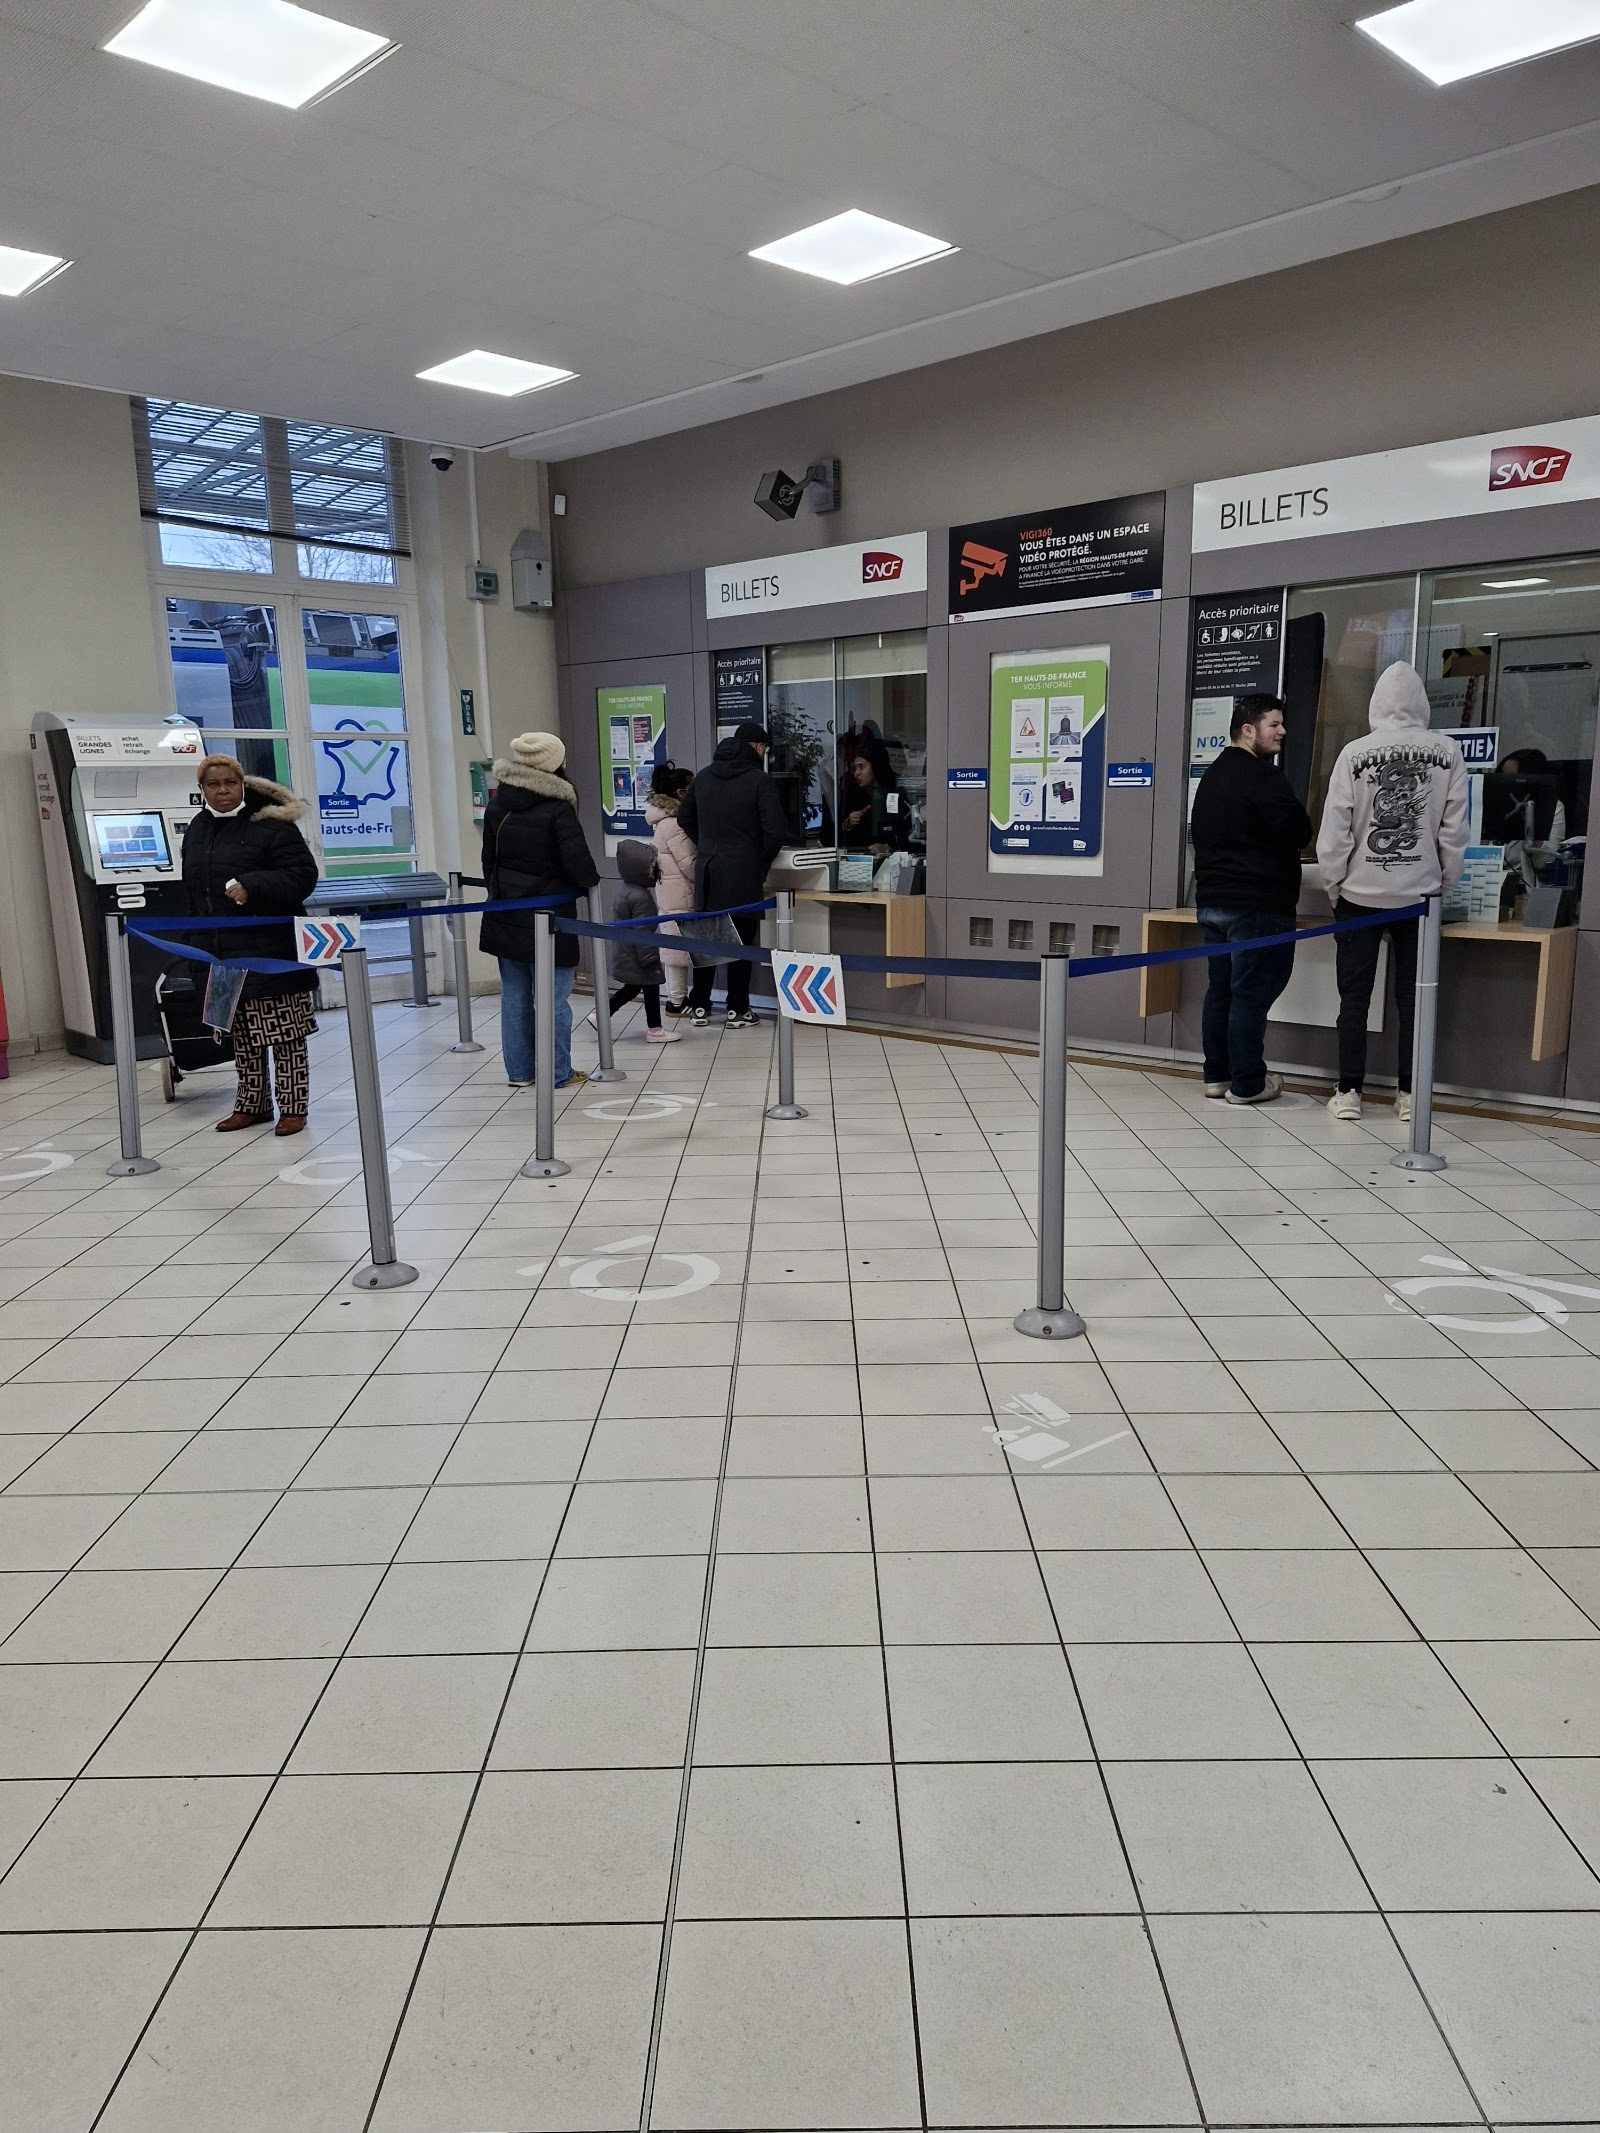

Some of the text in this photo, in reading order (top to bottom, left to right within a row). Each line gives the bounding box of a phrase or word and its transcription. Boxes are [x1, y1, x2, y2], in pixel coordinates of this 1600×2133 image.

[1492, 454, 1566, 486] SNCF
[1220, 487, 1329, 530] BILLETS
[1020, 527, 1052, 541] VIGI360
[1020, 523, 1149, 552] VOUS ÊTES DANS UN ESPACE
[1020, 543, 1092, 564] VIDÉO PROTÉGÉ.
[1030, 563, 1047, 572] VOTRE
[1079, 555, 1100, 564] RÉGION
[1100, 549, 1148, 562] HAUTS-DE-FRANCE
[864, 560, 900, 580] SNCF
[1097, 561, 1111, 569] DANS
[1111, 558, 1128, 567] VOTRE
[721, 575, 780, 603] BILLETS
[1199, 602, 1279, 620] Accès prioritaire
[717, 656, 762, 669] Accès prioritaire
[1023, 680, 1072, 690] VOUS INFORME
[1024, 671, 1087, 682] HAUTS-DE-FRANCE
[173, 745, 197, 753] SNCF
[1456, 739, 1485, 758] TIE
[1117, 766, 1143, 775] Sortie
[328, 798, 350, 806] Sortie
